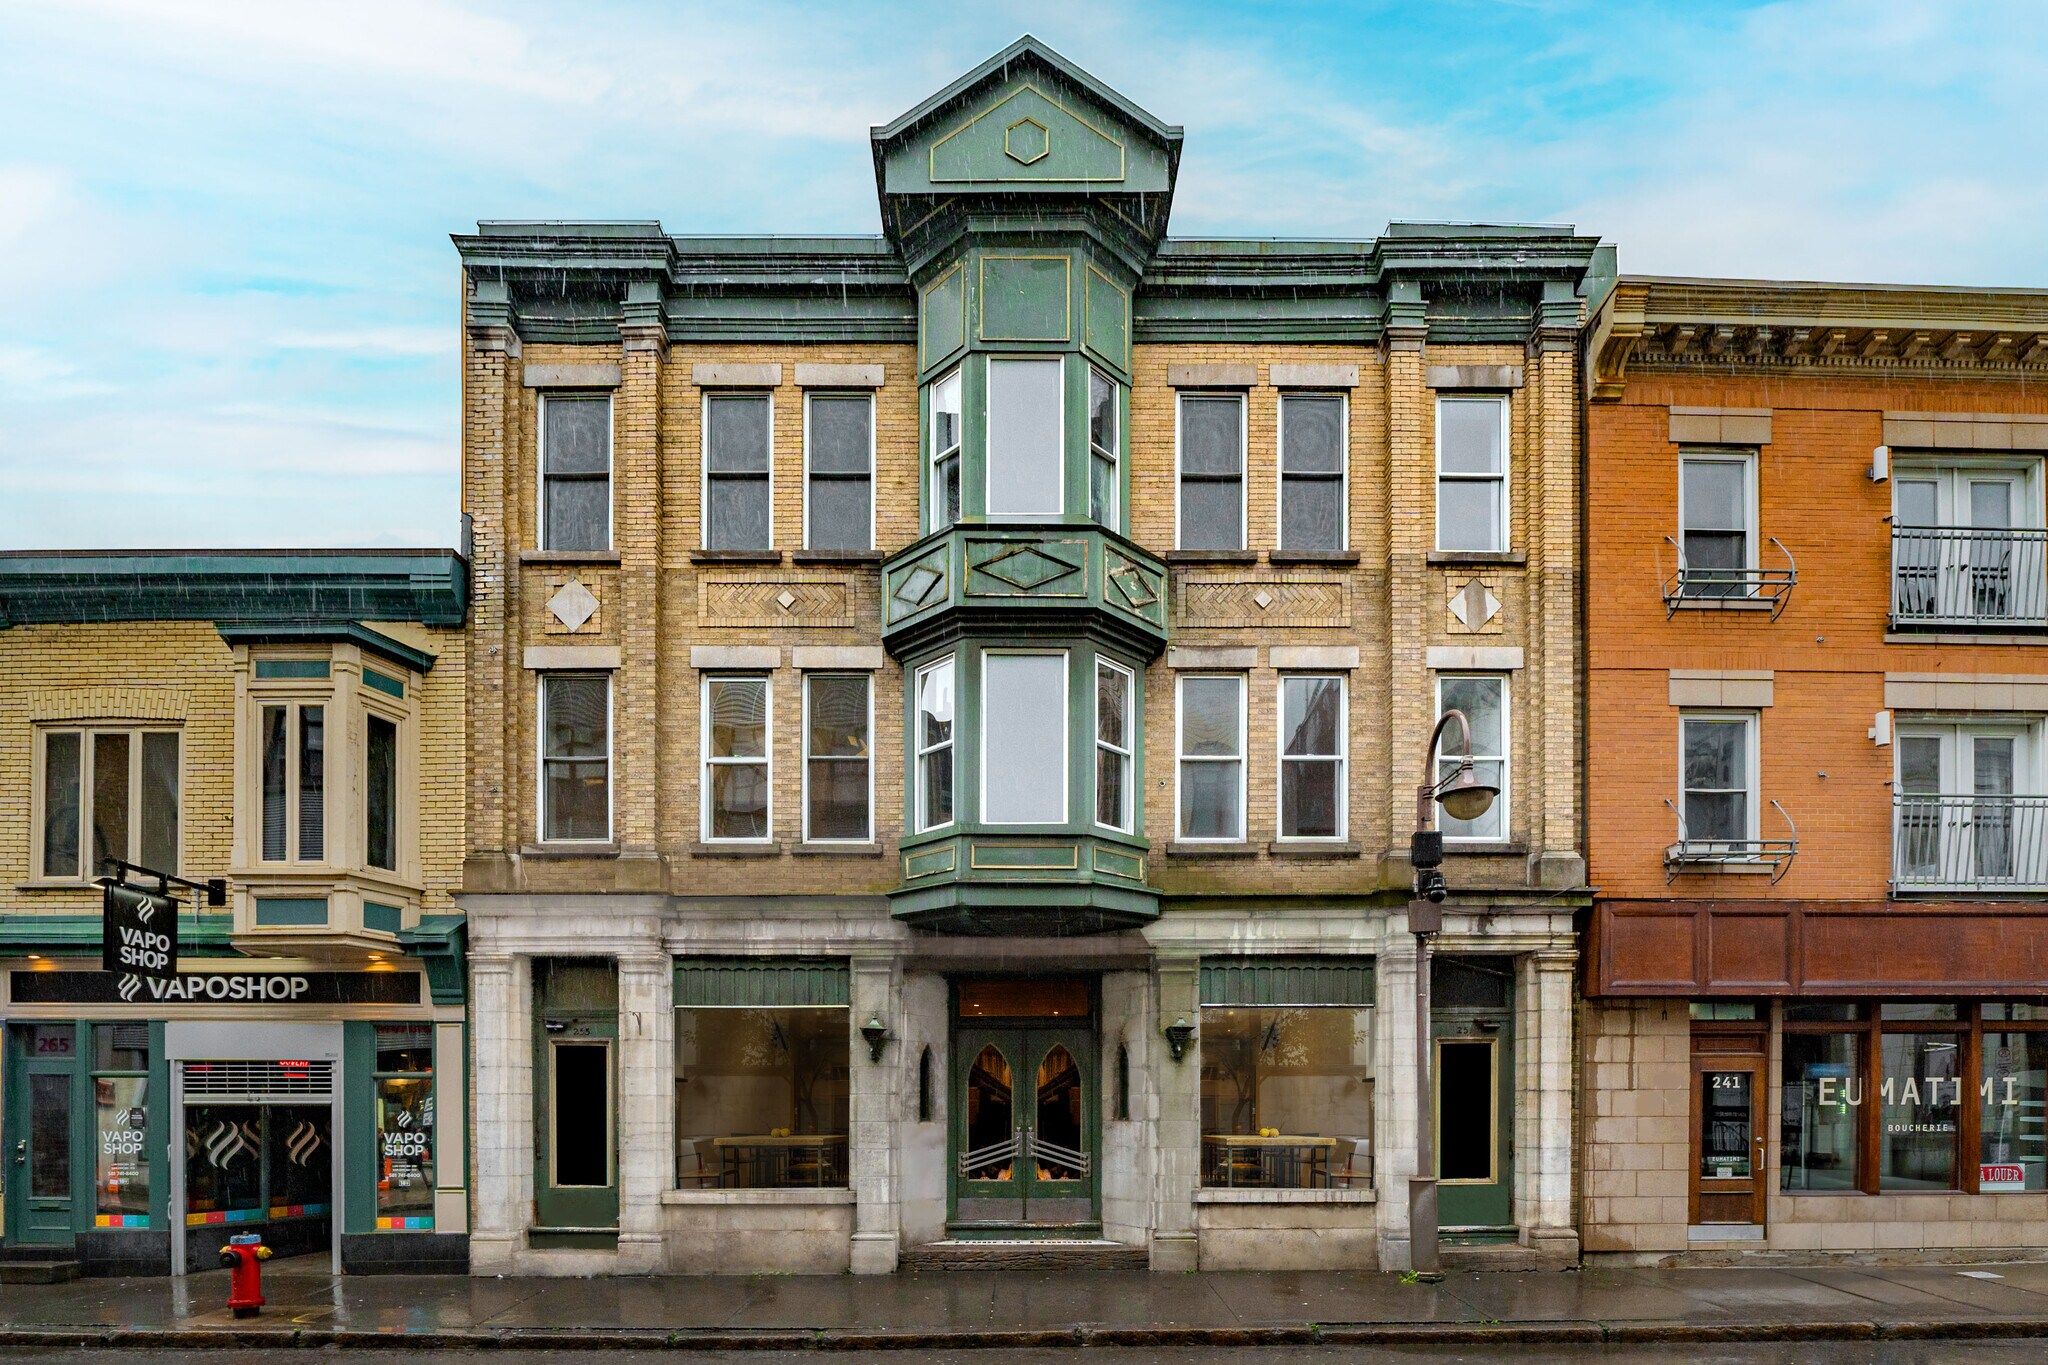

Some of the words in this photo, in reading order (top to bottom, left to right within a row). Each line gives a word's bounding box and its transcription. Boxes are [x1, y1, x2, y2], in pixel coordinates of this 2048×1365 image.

[119, 926, 171, 951] VAPO
[119, 946, 169, 970] SHOP
[147, 976, 309, 1000] VAPOSHOP
[38, 1038, 69, 1053] 265
[1712, 1076, 1741, 1089] 241
[1887, 1124, 1949, 1132] BOUCHERIE
[102, 1131, 144, 1143] VAPO
[383, 1132, 426, 1145] VAPO
[103, 1143, 143, 1155] SHOP
[384, 1144, 425, 1156] SHOP
[1989, 1168, 2019, 1181] LOUER
